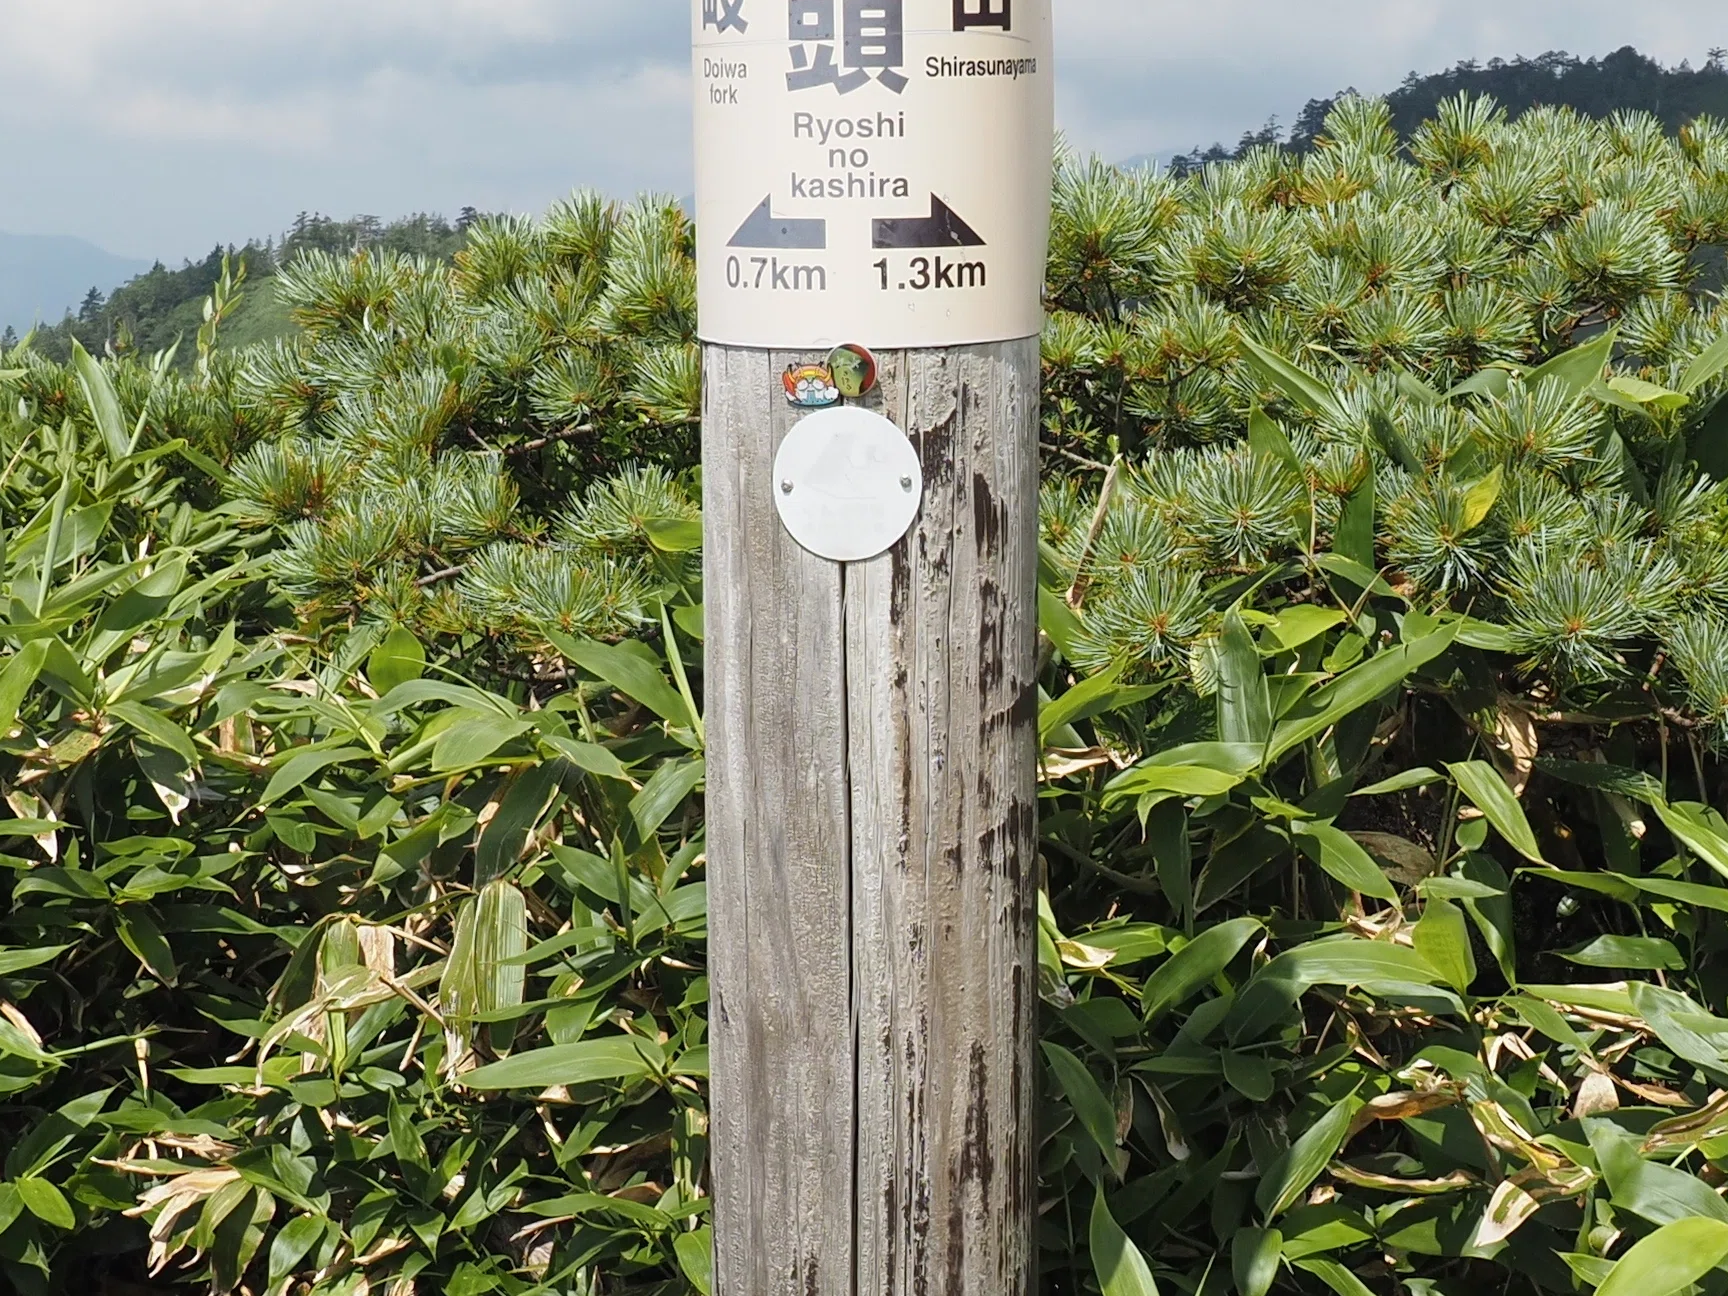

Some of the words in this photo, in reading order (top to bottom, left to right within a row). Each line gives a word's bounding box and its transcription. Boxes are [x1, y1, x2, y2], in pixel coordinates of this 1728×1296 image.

[703, 58, 747, 79] Doiwa
[925, 57, 1037, 80] Shirasunayama
[709, 84, 738, 104] fork
[794, 112, 905, 144] Ryoshi
[829, 148, 869, 167] no
[791, 173, 909, 198] kashira
[726, 255, 826, 290] 0.7km
[873, 257, 986, 290] 1.3km
